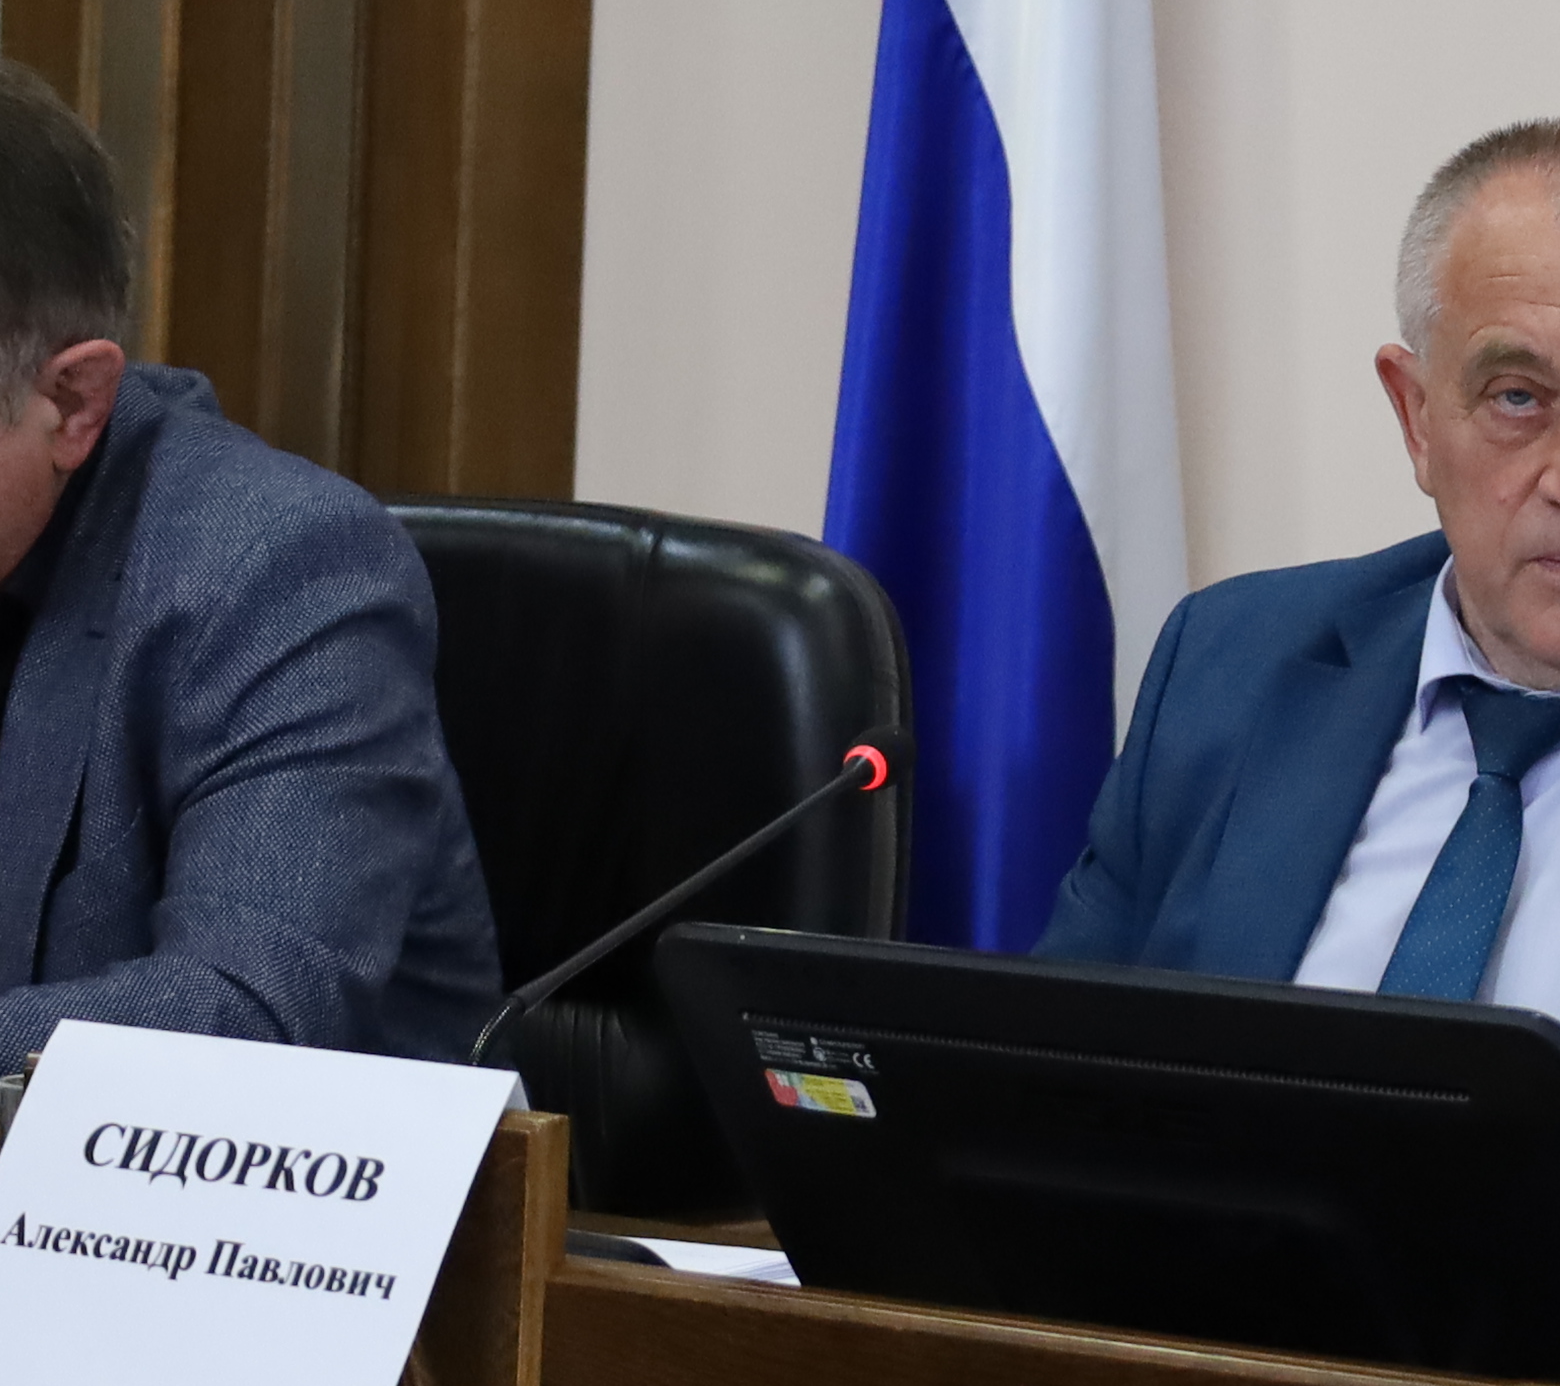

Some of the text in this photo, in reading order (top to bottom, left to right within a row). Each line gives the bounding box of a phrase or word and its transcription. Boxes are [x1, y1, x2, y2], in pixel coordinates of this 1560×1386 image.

[83, 1122, 385, 1202] СИДОРКОВ
[0, 1212, 398, 1301] Александр Павлович
